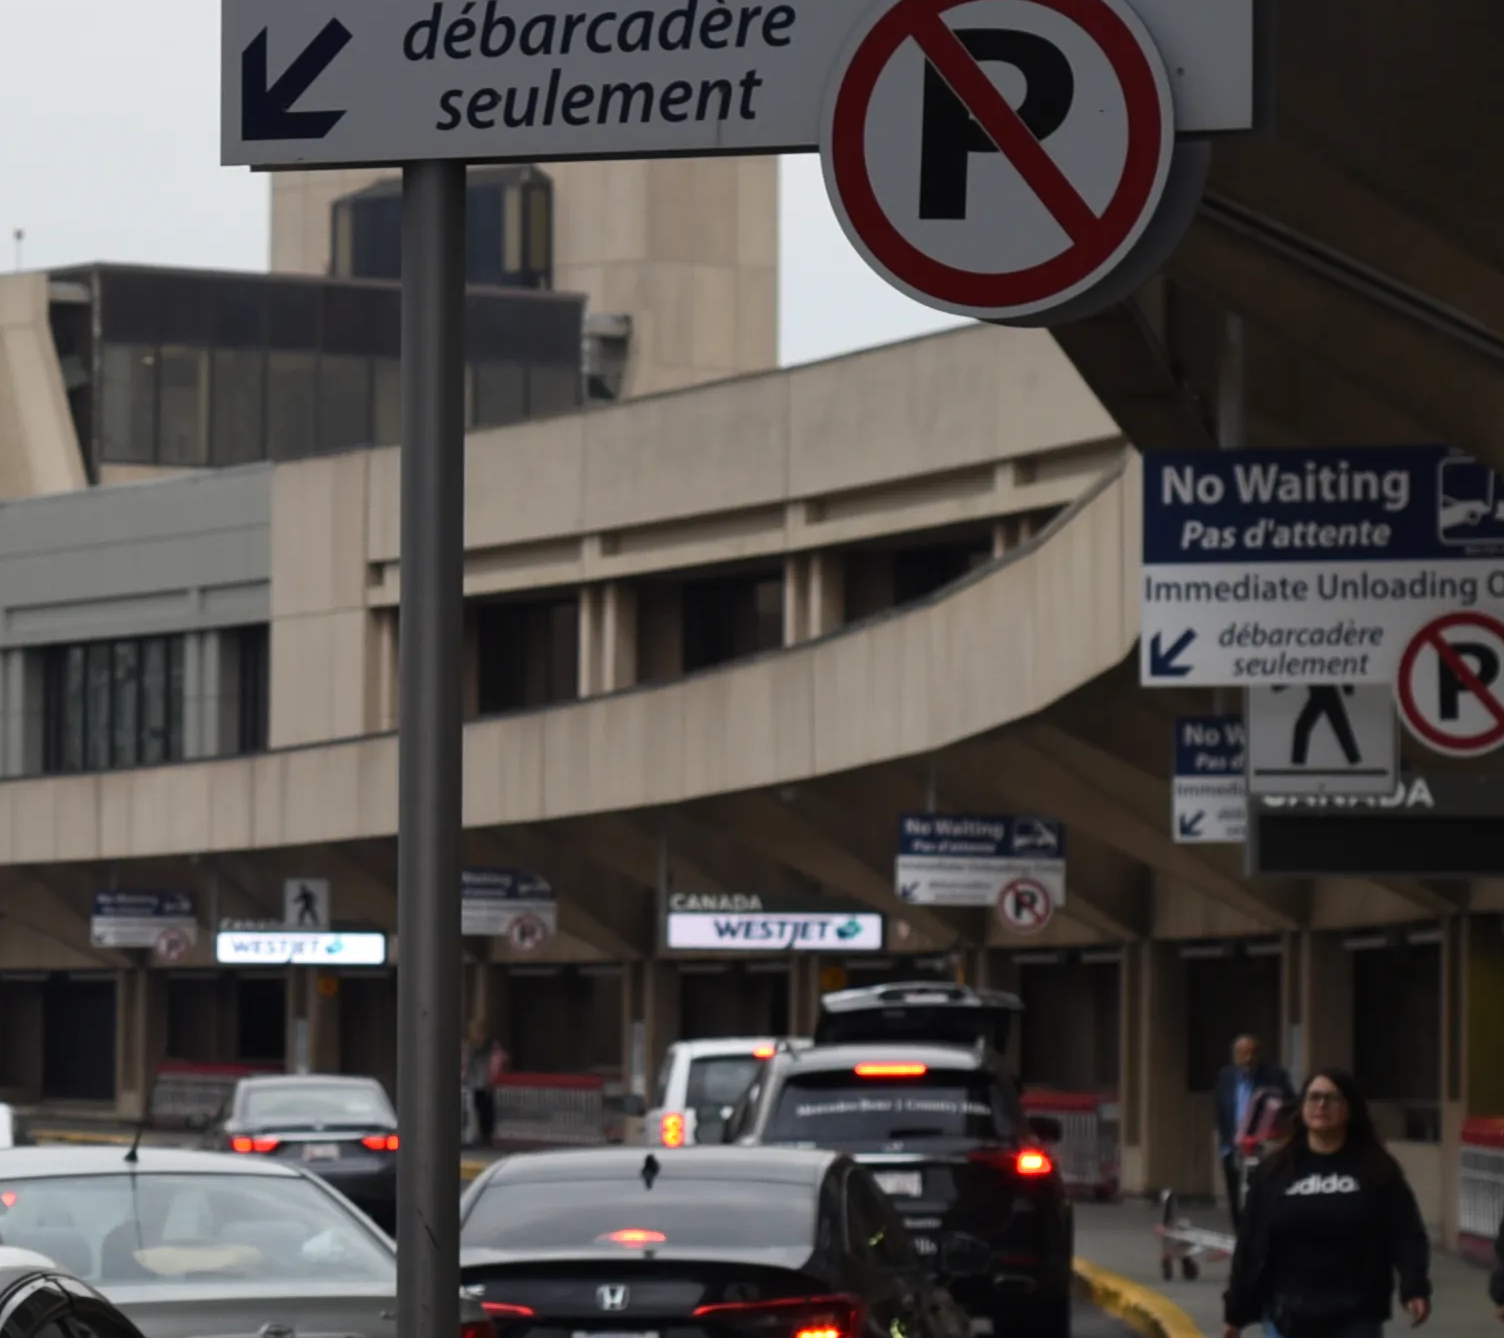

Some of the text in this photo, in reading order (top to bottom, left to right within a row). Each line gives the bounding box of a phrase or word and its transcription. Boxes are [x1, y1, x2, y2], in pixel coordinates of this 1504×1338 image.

[435, 67, 763, 131] seulement
[1160, 459, 1411, 512] No Waiting
[1180, 516, 1392, 551] Pas d'attente
[1145, 573, 1308, 603] Immediate
[1318, 569, 1478, 606] Unloading
[1219, 618, 1384, 648] débarcadère
[1234, 652, 1369, 677] seulement
[1183, 722, 1219, 747] No
[904, 818, 1005, 842] No Waiting
[669, 893, 763, 911] CANADA
[713, 920, 830, 949] WESTJET
